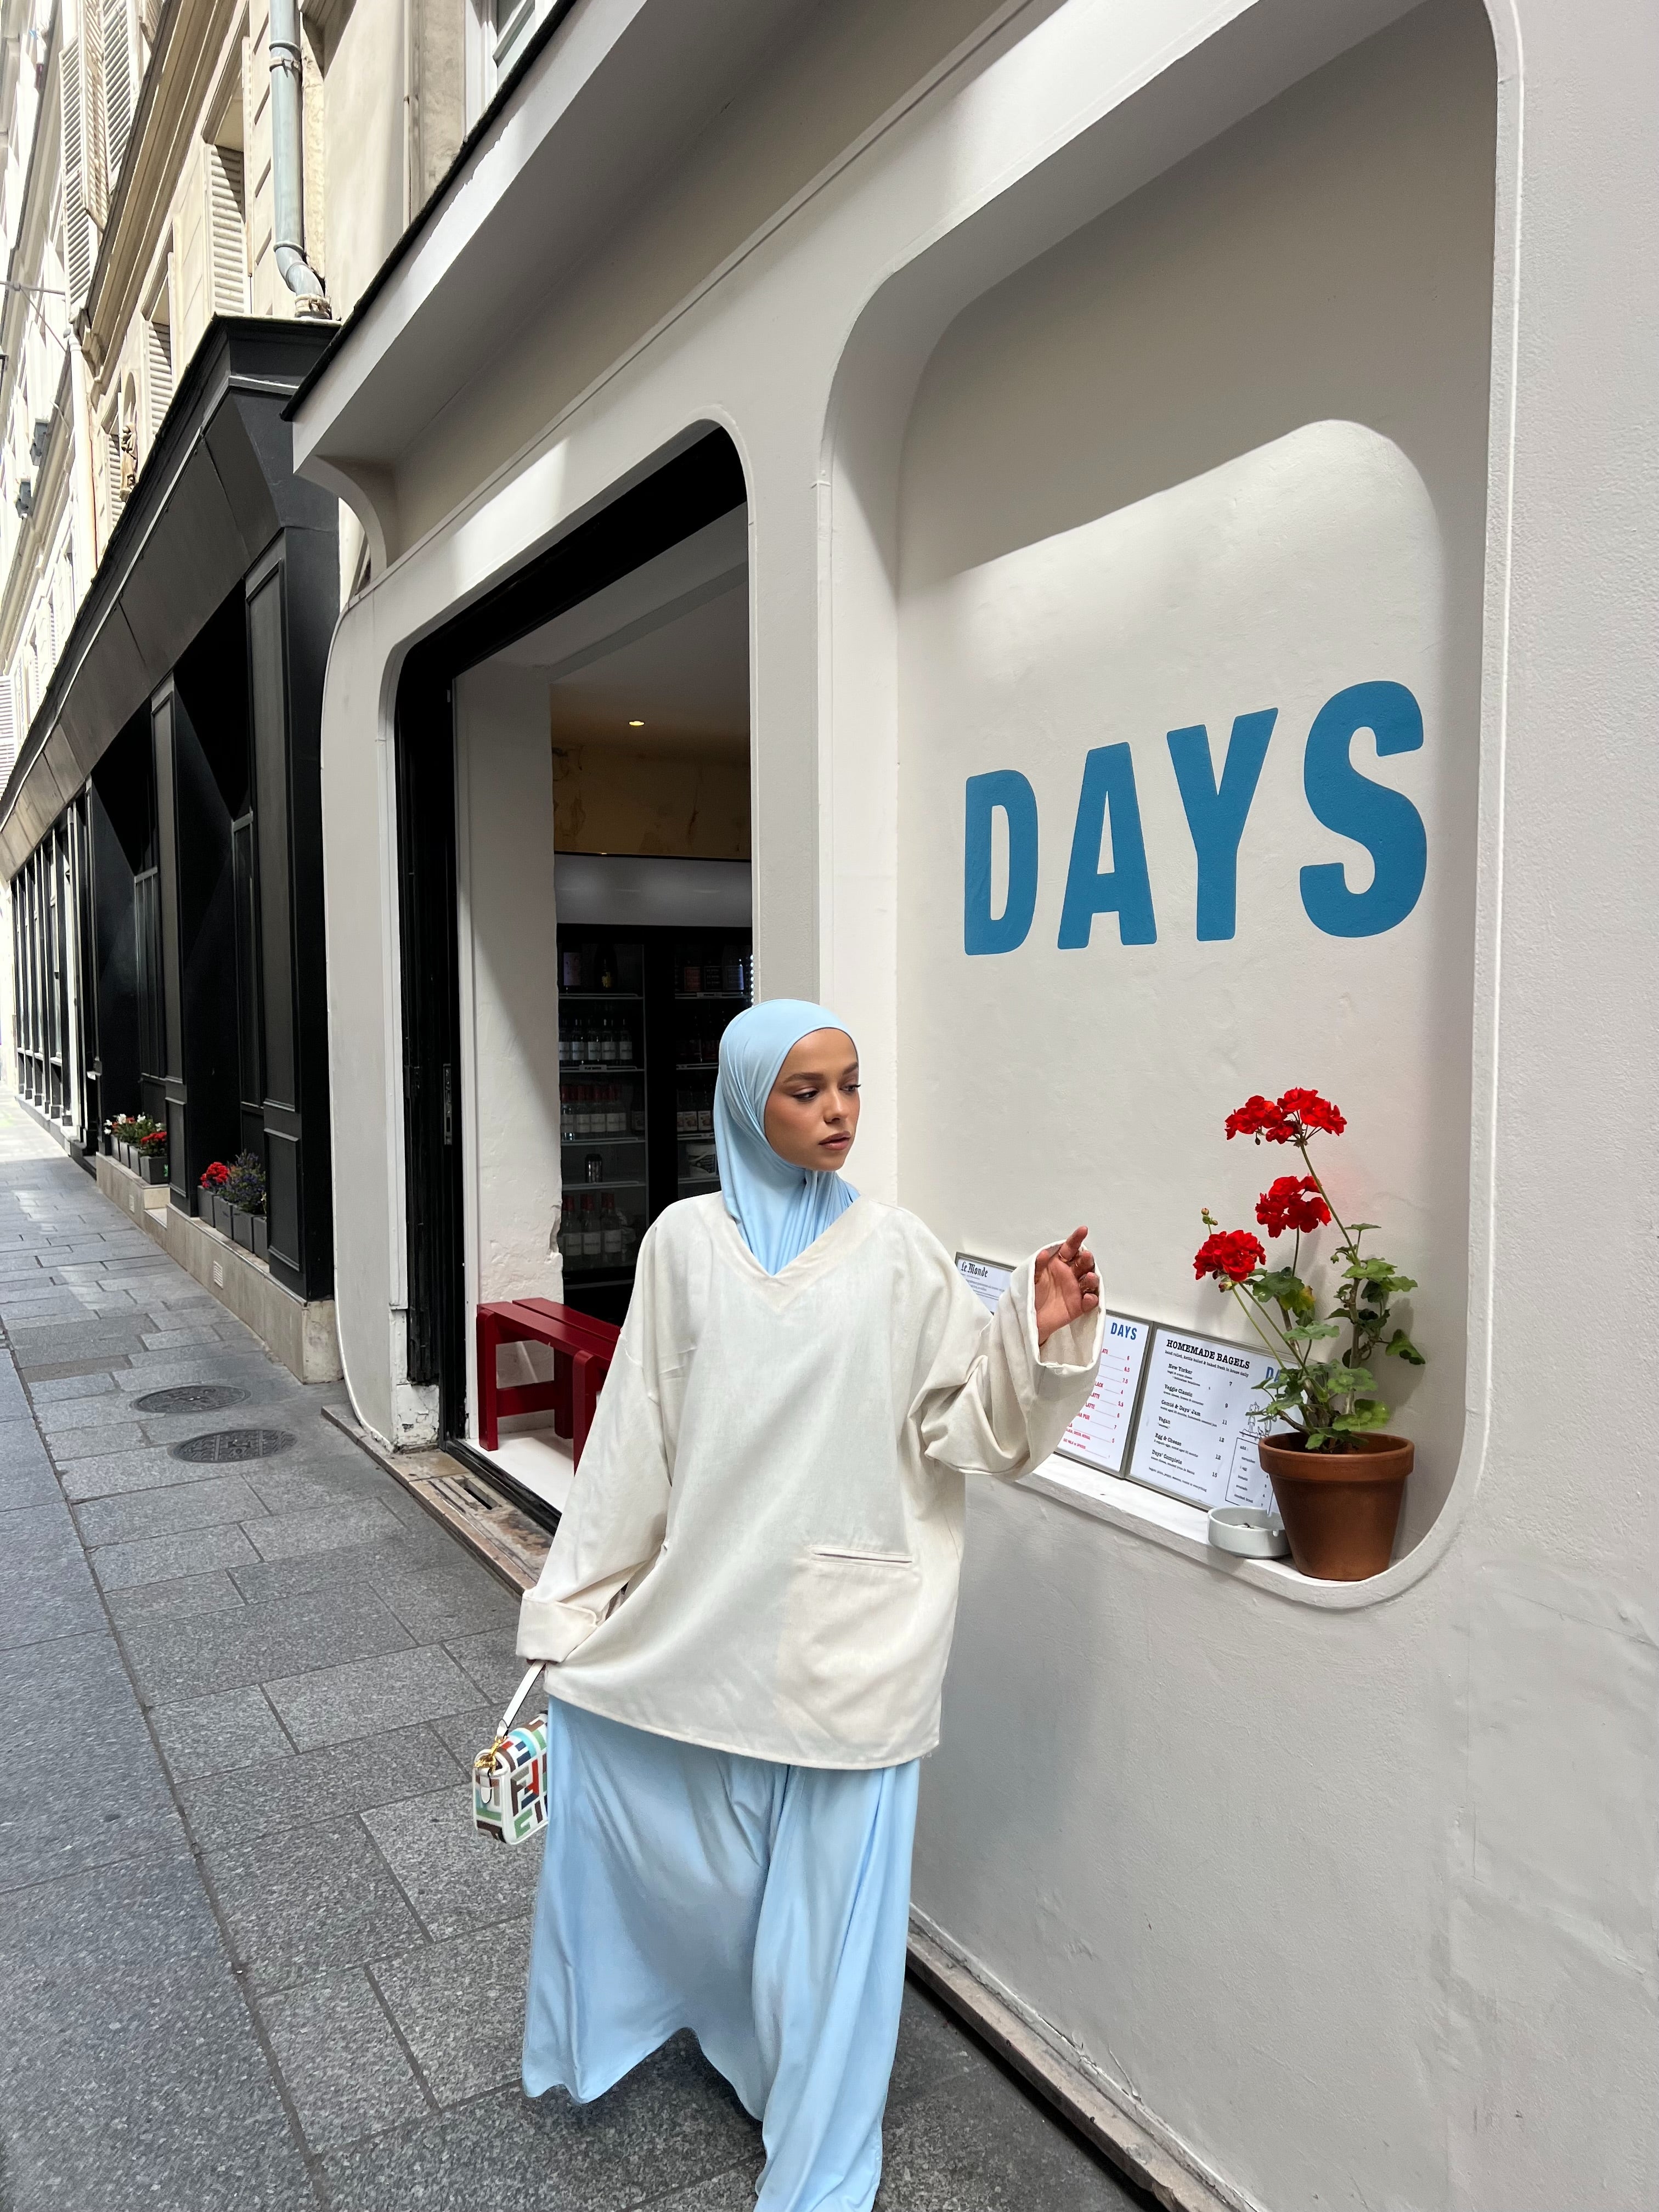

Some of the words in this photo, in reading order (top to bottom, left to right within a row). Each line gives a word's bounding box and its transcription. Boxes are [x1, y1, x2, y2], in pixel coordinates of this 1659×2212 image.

[964, 681, 1427, 955] DAYS
[961, 1261, 968, 1272] Le
[967, 1263, 988, 1278] Monde
[1110, 1322, 1137, 1340] DAYS
[1166, 1339, 1215, 1359] HOMEMADE
[1216, 1353, 1250, 1369] BAGELS
[1178, 1366, 1193, 1374] Yorker
[1165, 1384, 1178, 1392] Veggie
[1178, 1389, 1193, 1397] Classic
[1158, 1416, 1171, 1424] Vegan
[1167, 1437, 1182, 1446] Cheese
[1164, 1454, 1182, 1465] Complete
